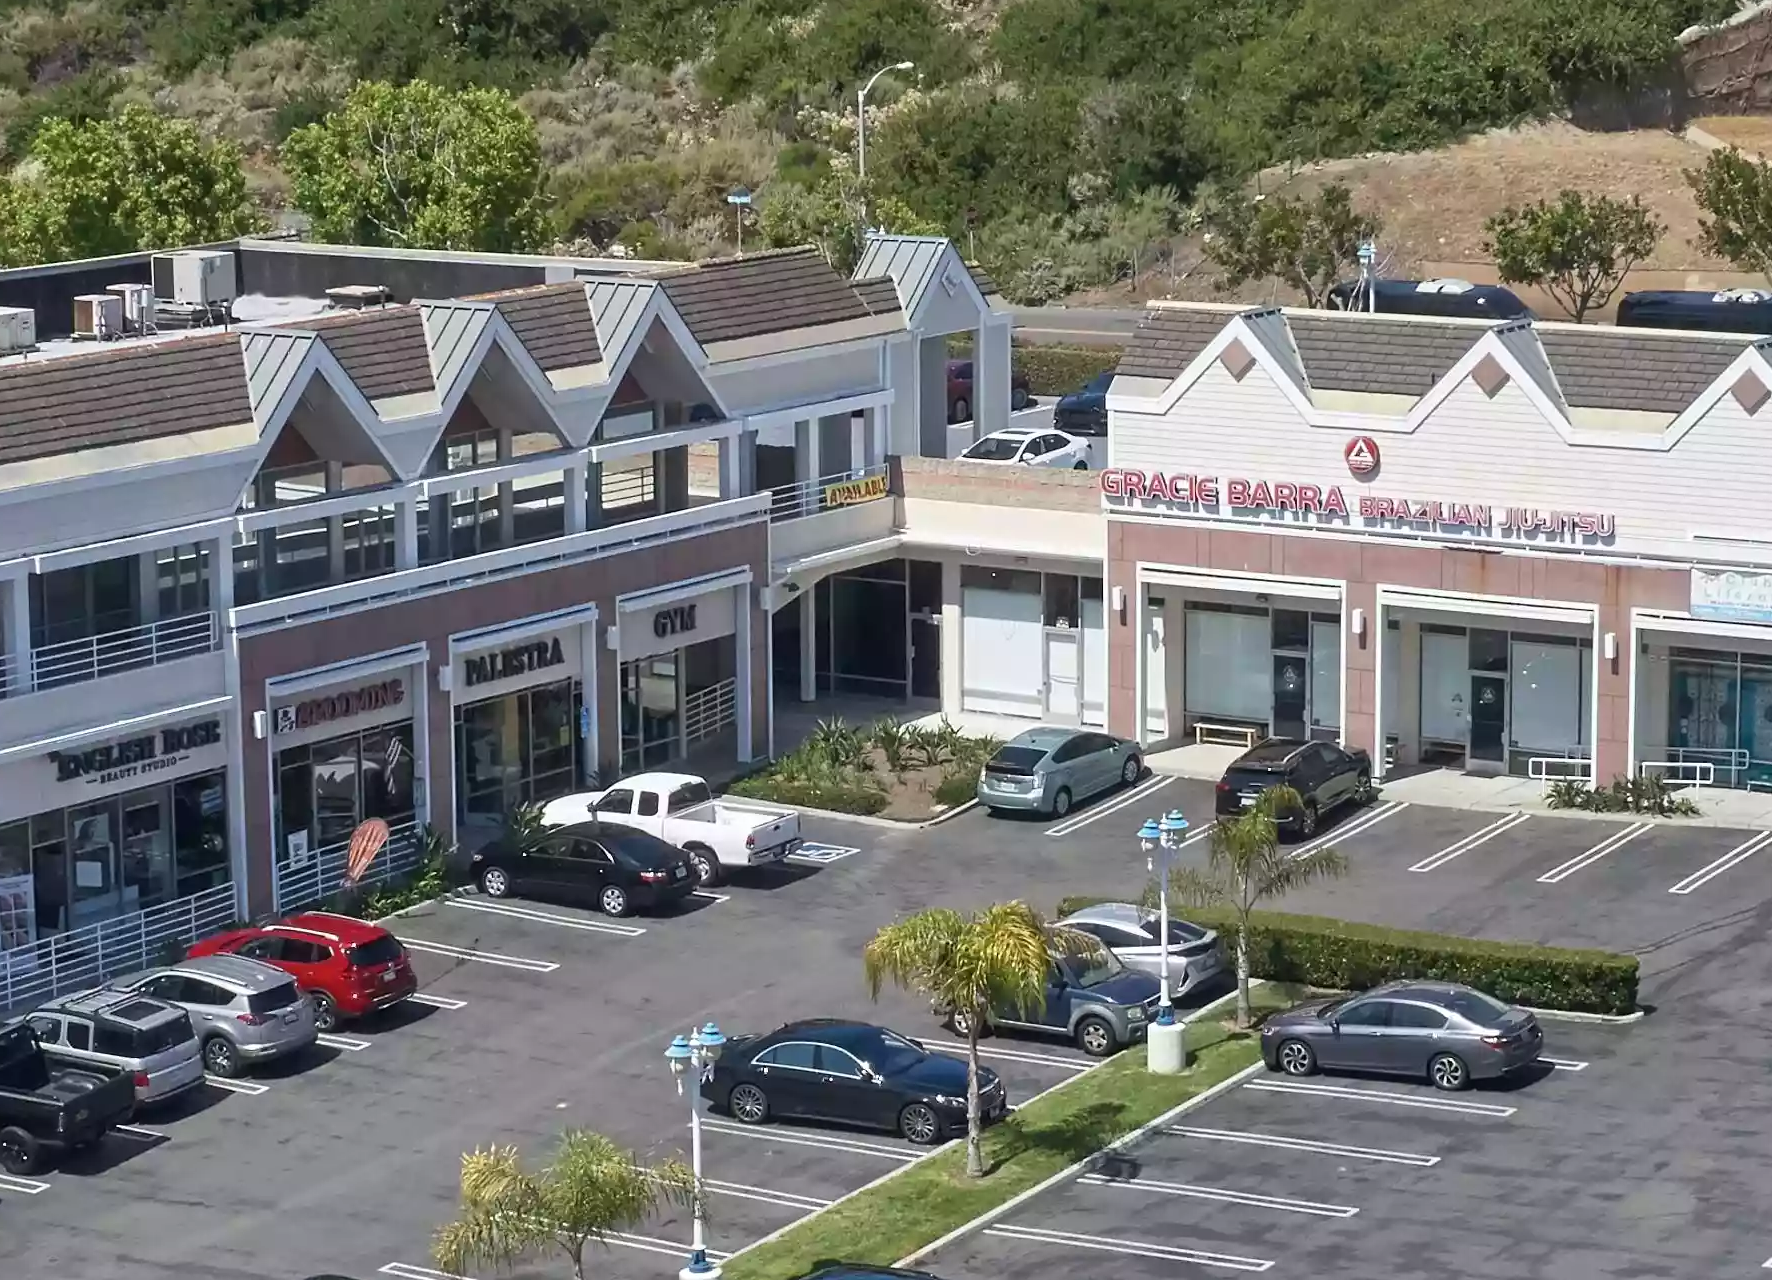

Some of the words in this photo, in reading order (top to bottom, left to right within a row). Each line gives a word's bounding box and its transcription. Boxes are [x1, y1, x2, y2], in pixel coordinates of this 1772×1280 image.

[829, 476, 887, 505] AVAILABLE
[1100, 468, 1220, 505] GRACIE
[1226, 479, 1347, 515] BARRA
[1359, 496, 1491, 528] BRAZILIAN
[1498, 506, 1616, 537] JIU-JITSU
[653, 604, 698, 638] GYM
[464, 636, 566, 687] PALESTRA
[296, 678, 405, 729] GROOMING
[55, 734, 157, 782] ENGLISH
[160, 719, 221, 755] ROSE
[99, 765, 138, 784] BEAUTY
[141, 756, 177, 774] STUDIO
